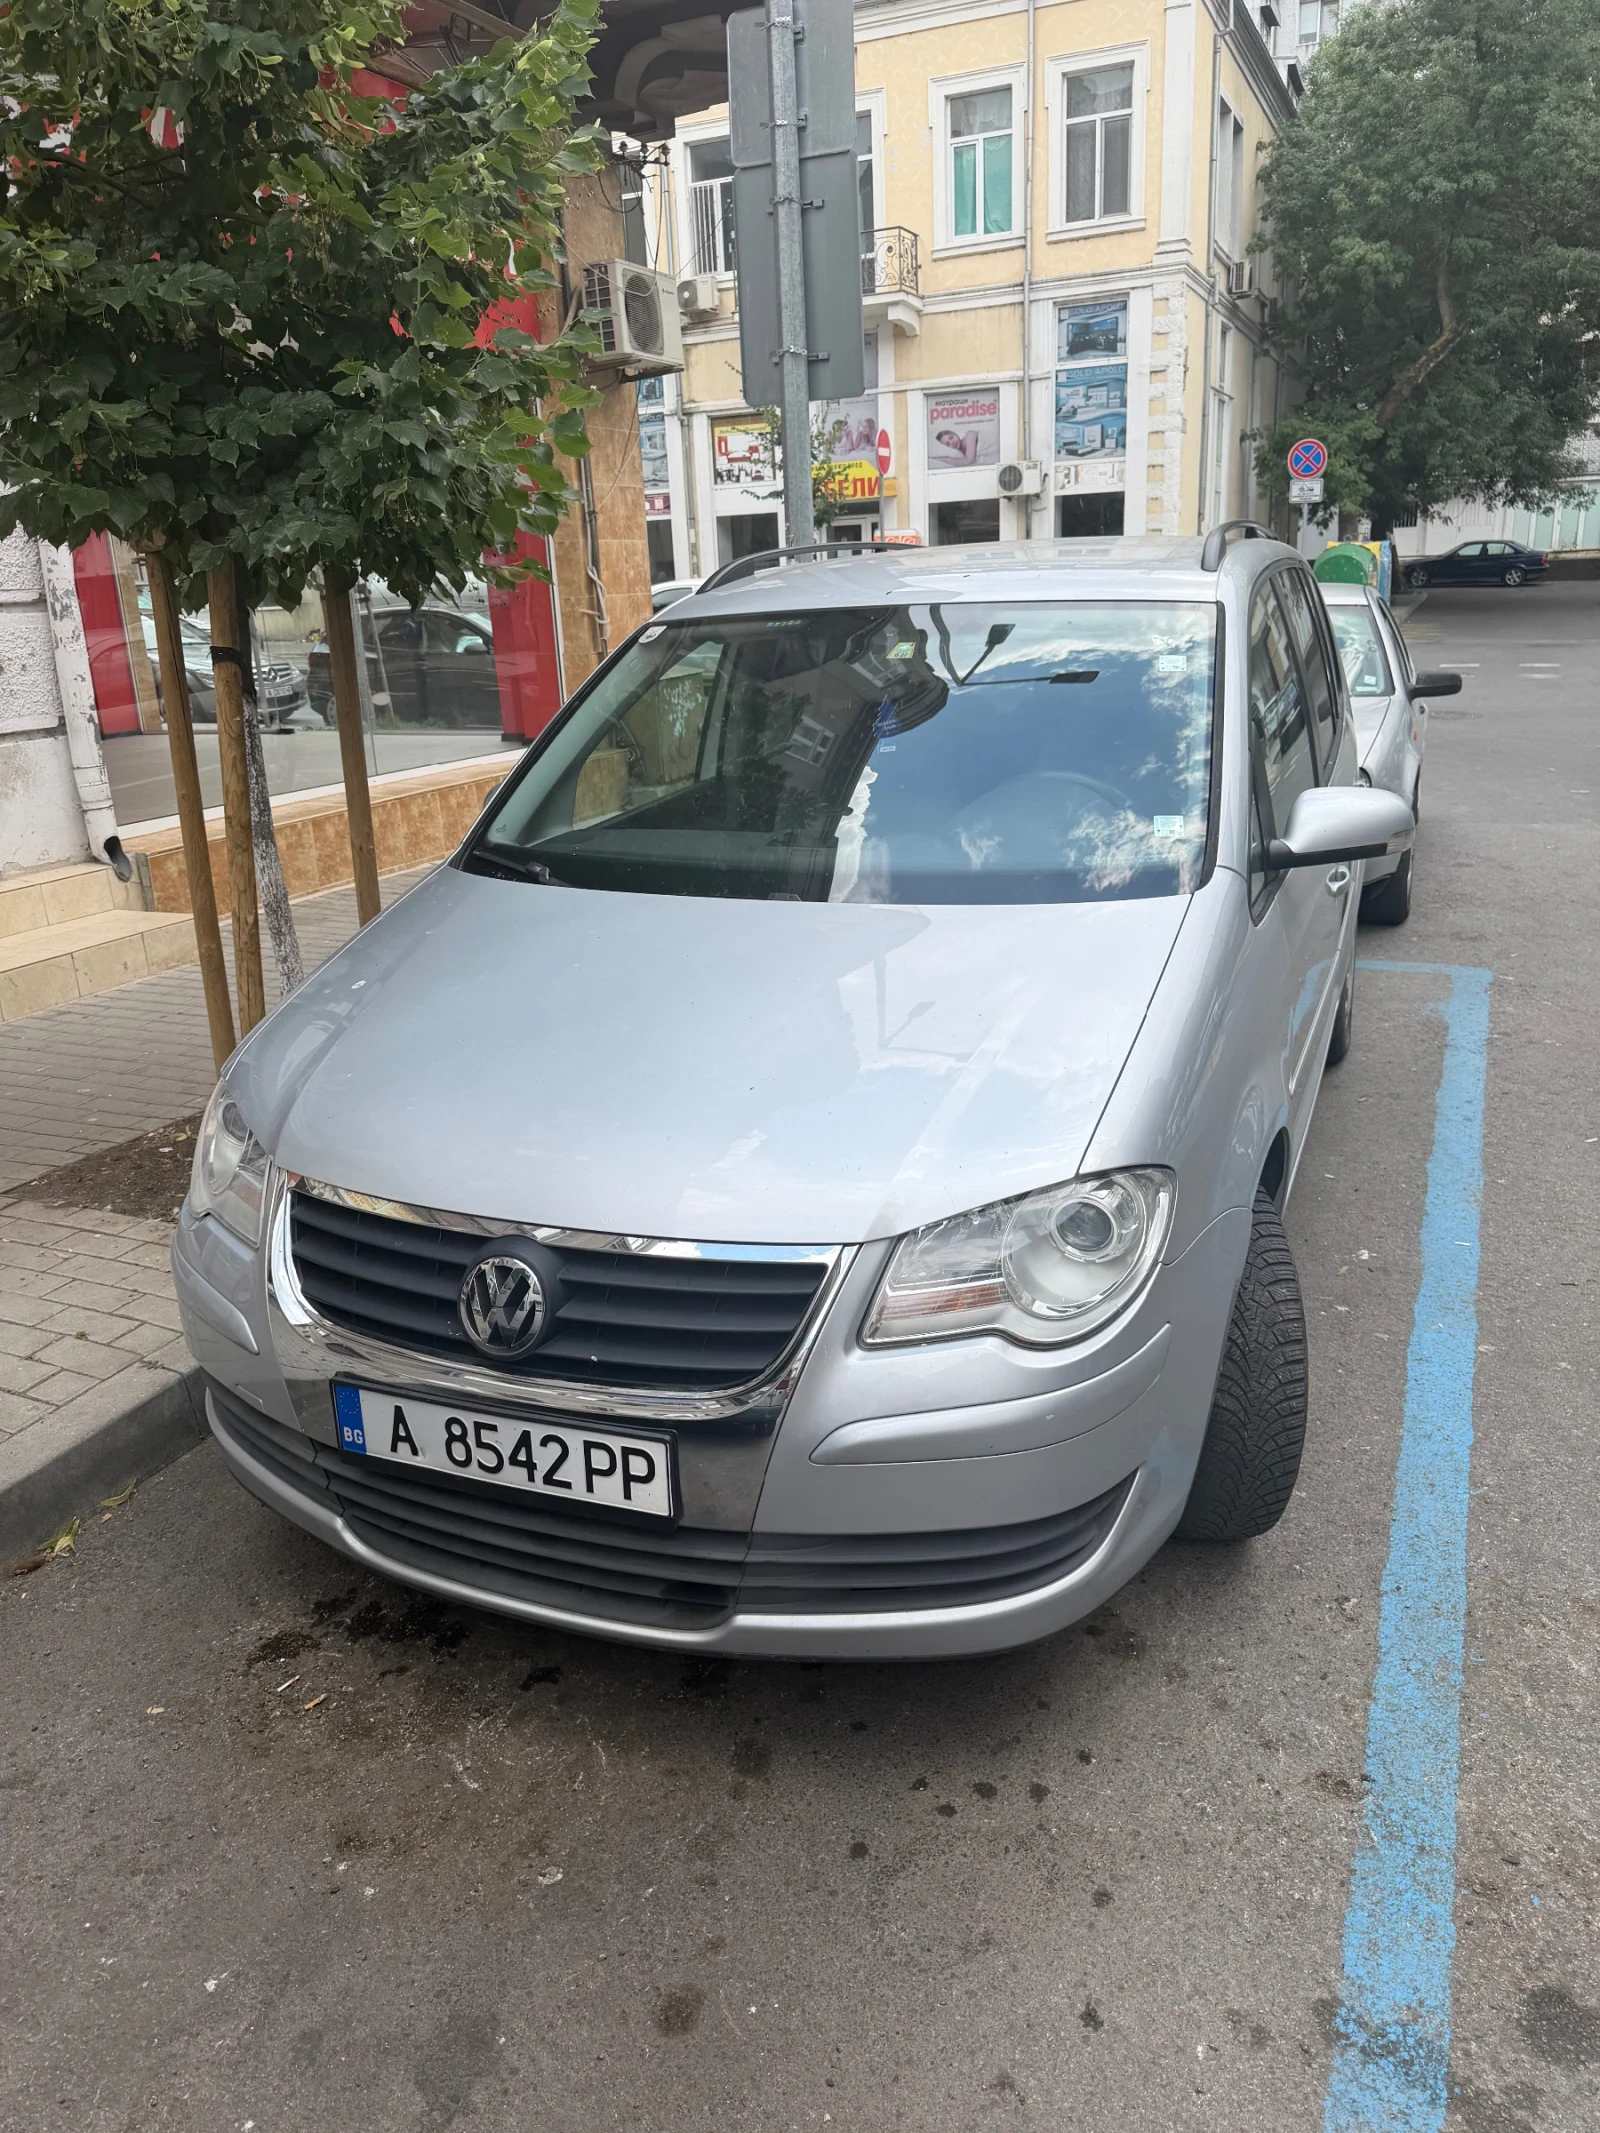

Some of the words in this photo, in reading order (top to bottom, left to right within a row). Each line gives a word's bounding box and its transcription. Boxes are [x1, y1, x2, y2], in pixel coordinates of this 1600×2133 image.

[1070, 306, 1092, 316] GOLD
[1095, 302, 1124, 313] APOLO
[1067, 368, 1092, 378] GOLD
[1094, 365, 1125, 376] APOLO
[930, 400, 997, 425] paradise
[343, 1426, 364, 1445] BG
[389, 1404, 420, 1457] A
